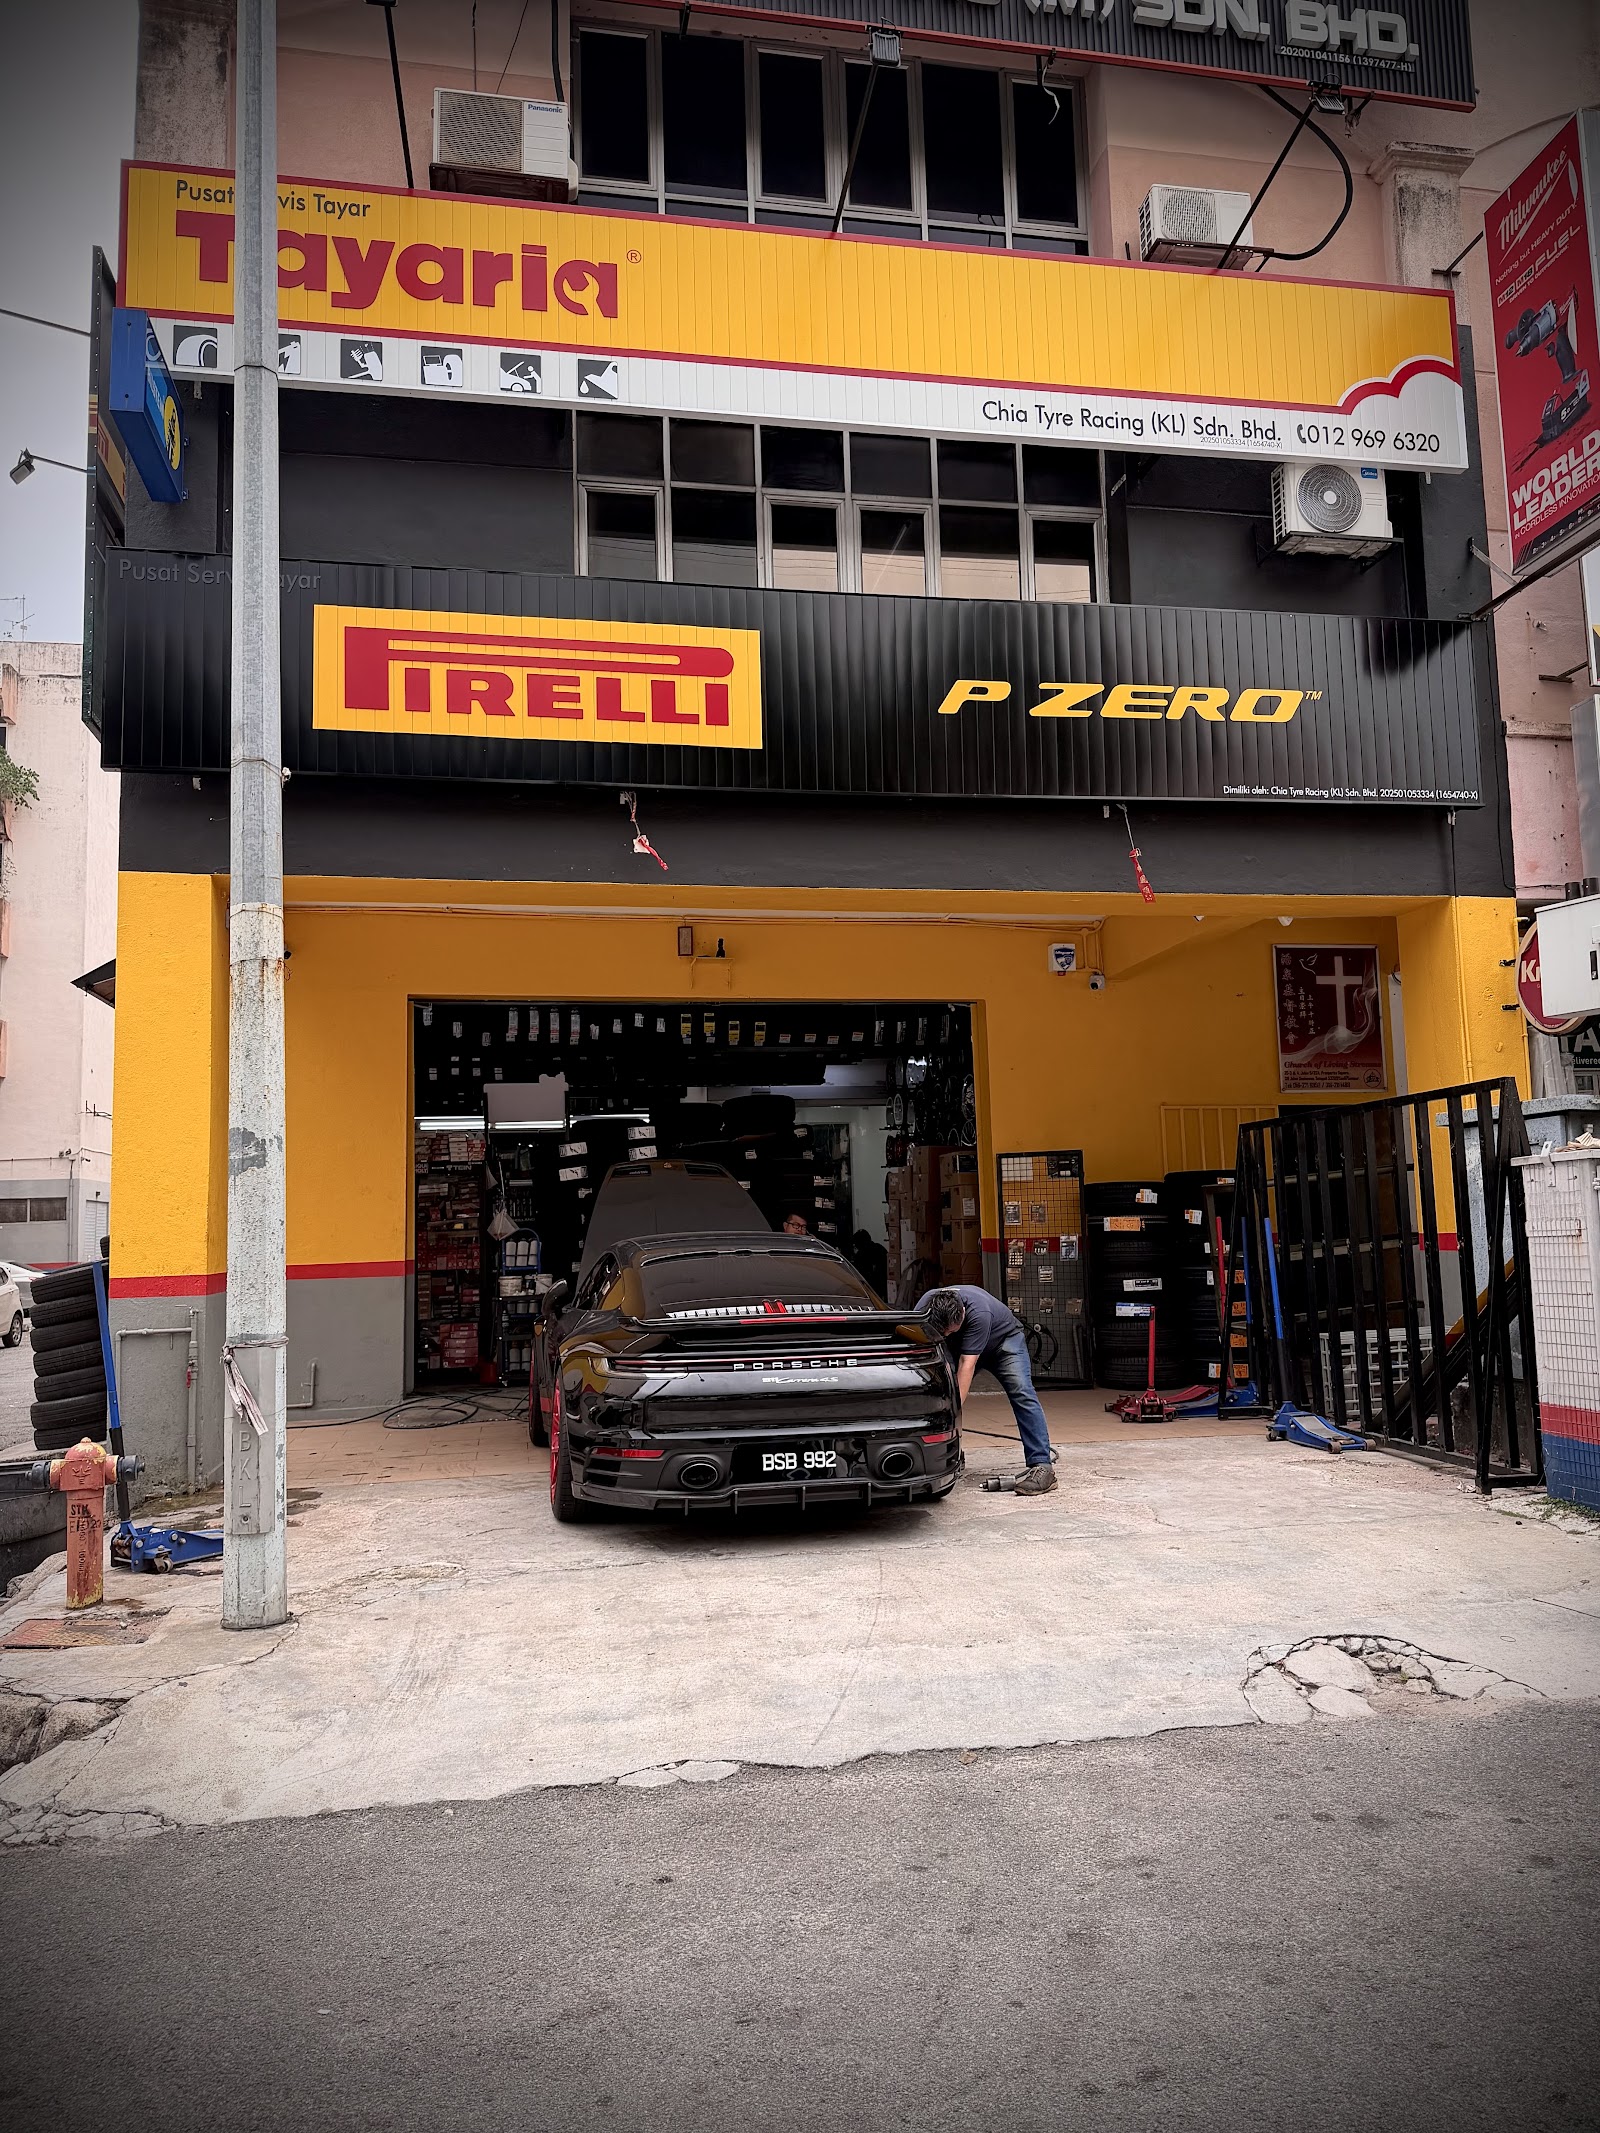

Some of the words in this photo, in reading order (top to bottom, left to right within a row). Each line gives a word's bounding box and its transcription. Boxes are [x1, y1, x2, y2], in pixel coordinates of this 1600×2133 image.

[1286, 1, 1419, 60] BHD.
[1280, 45, 1350, 64] 202001041156
[1353, 55, 1412, 73] (1397477-H)
[527, 103, 563, 114] Panasonic
[176, 179, 235, 204] Pusat
[277, 190, 306, 211] vis
[313, 193, 371, 220] Tayar
[1495, 149, 1568, 250] Milwaukee
[176, 209, 618, 318] Tayaria
[1495, 260, 1519, 286] Nothing
[1520, 248, 1530, 262] but
[1530, 222, 1555, 251] HEAVY
[1535, 226, 1581, 271] FUEL
[982, 400, 1028, 423] Chia
[1034, 404, 1074, 430] Tyre
[1080, 408, 1144, 437] Racing
[1151, 411, 1186, 436] (KL)
[1193, 416, 1234, 438] Sdn.
[1241, 420, 1281, 441] Bhd.
[1307, 424, 1345, 445] 012
[1351, 428, 1386, 449] 969
[1393, 432, 1440, 452] 6320
[1512, 430, 1600, 508] WORLD
[1520, 503, 1558, 536] CORDLESS
[1559, 472, 1600, 509] INNOVATIO
[119, 558, 180, 582] Pusat
[344, 626, 734, 727] PIRELLI
[938, 679, 1011, 714] P
[1029, 682, 1304, 723] ZERO
[1223, 785, 1250, 794] Dimiliki
[1251, 786, 1269, 795] oleh:
[1270, 786, 1288, 795] Chia
[1289, 787, 1304, 797] Tyre
[1305, 788, 1329, 798] Racing
[1330, 788, 1344, 797] (KL)
[1345, 788, 1361, 797] Sdn.
[1363, 788, 1378, 797] Bhd.
[1380, 789, 1435, 798] 202501053334
[1436, 789, 1479, 800] (1654740-X)
[733, 1359, 858, 1371] PORSCHE
[762, 1452, 797, 1471] BSB
[803, 1450, 837, 1469] 992
